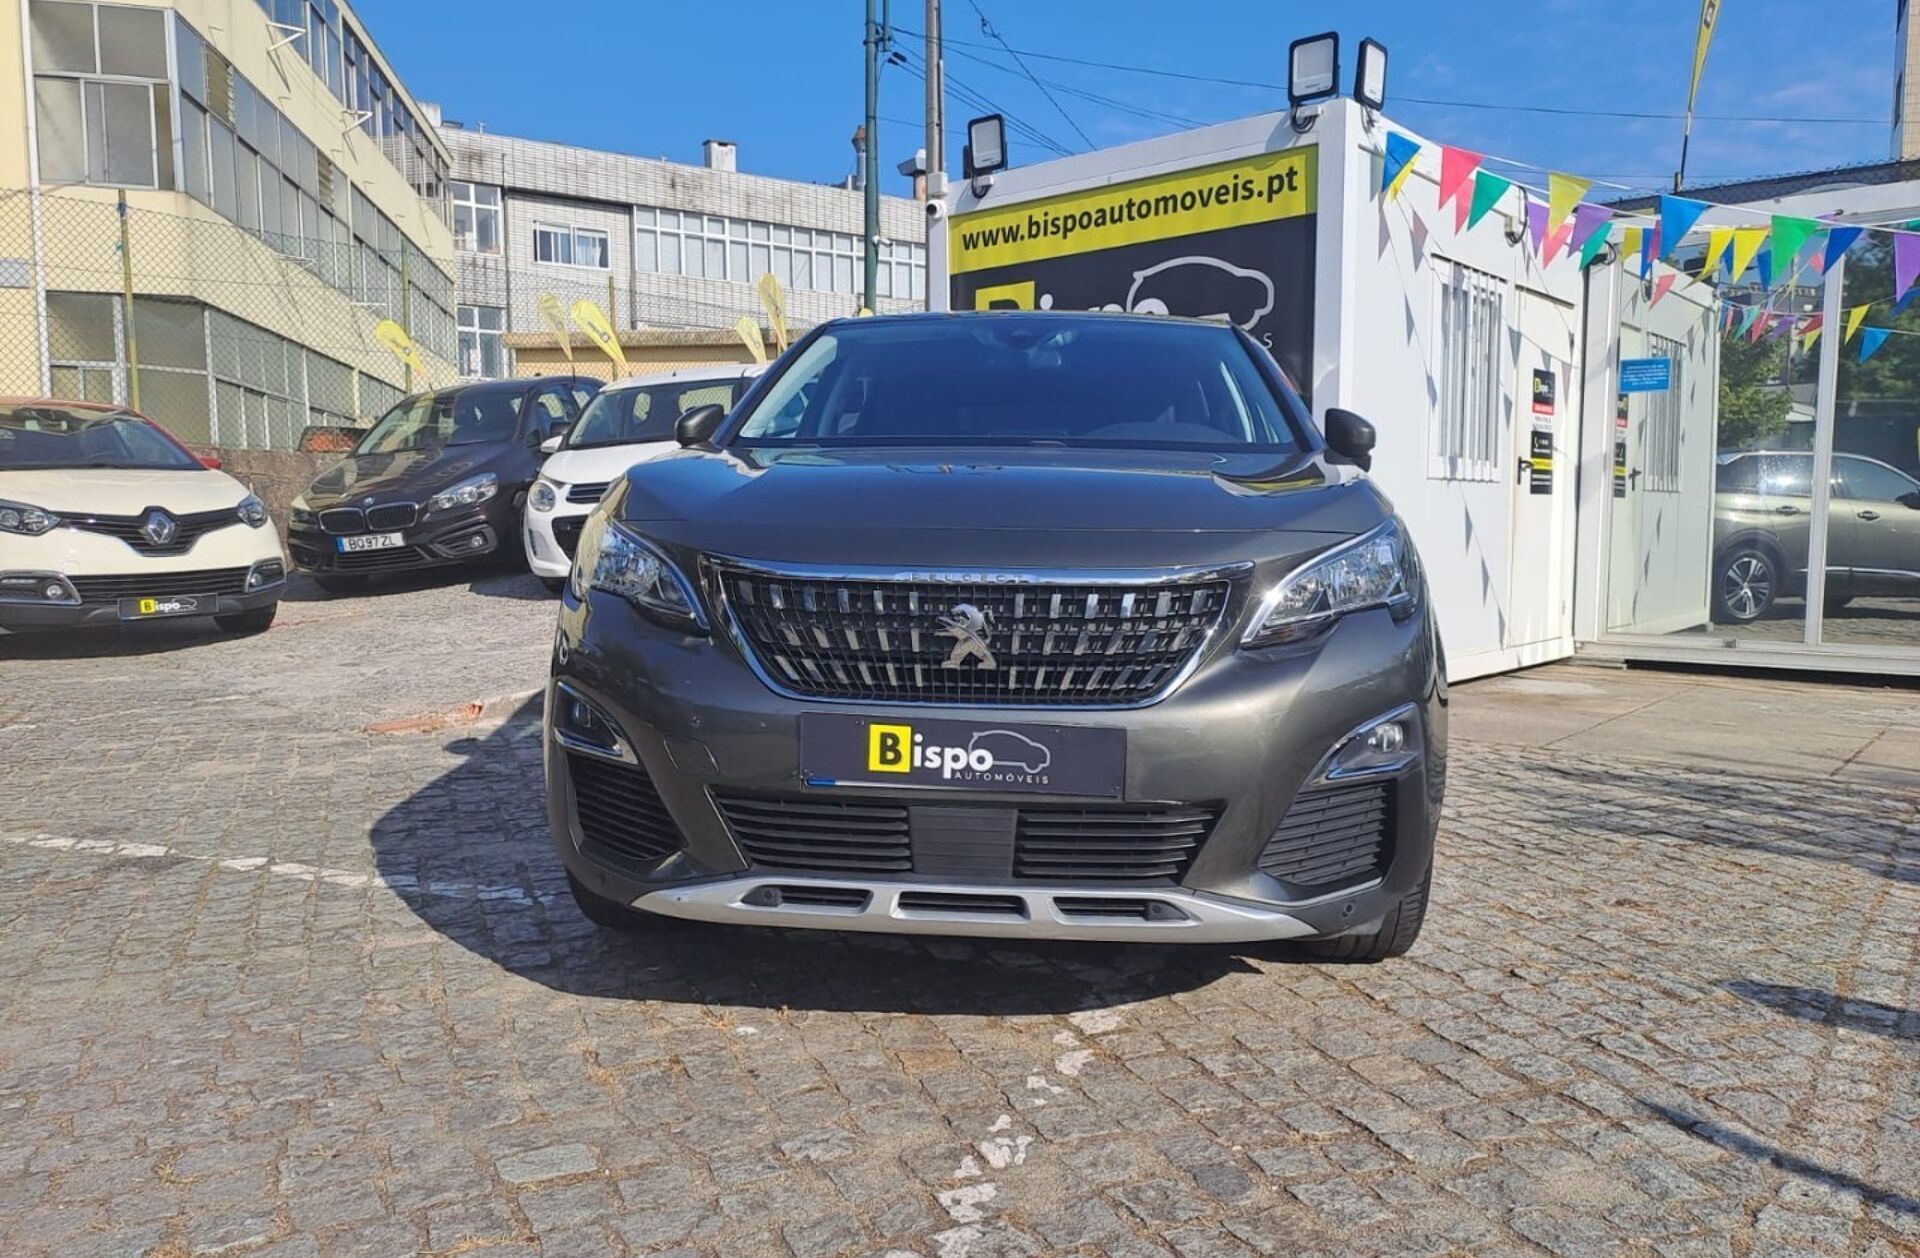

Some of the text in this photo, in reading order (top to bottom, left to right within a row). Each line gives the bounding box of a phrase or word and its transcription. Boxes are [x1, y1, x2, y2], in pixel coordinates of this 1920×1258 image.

[962, 166, 1299, 251] www.bispoautomoveis.pt
[910, 572, 1024, 584] PEUGEOT
[143, 600, 181, 613] Bispo
[879, 732, 994, 779] Bispo
[953, 772, 1050, 785] AUTOMÓVEIS
